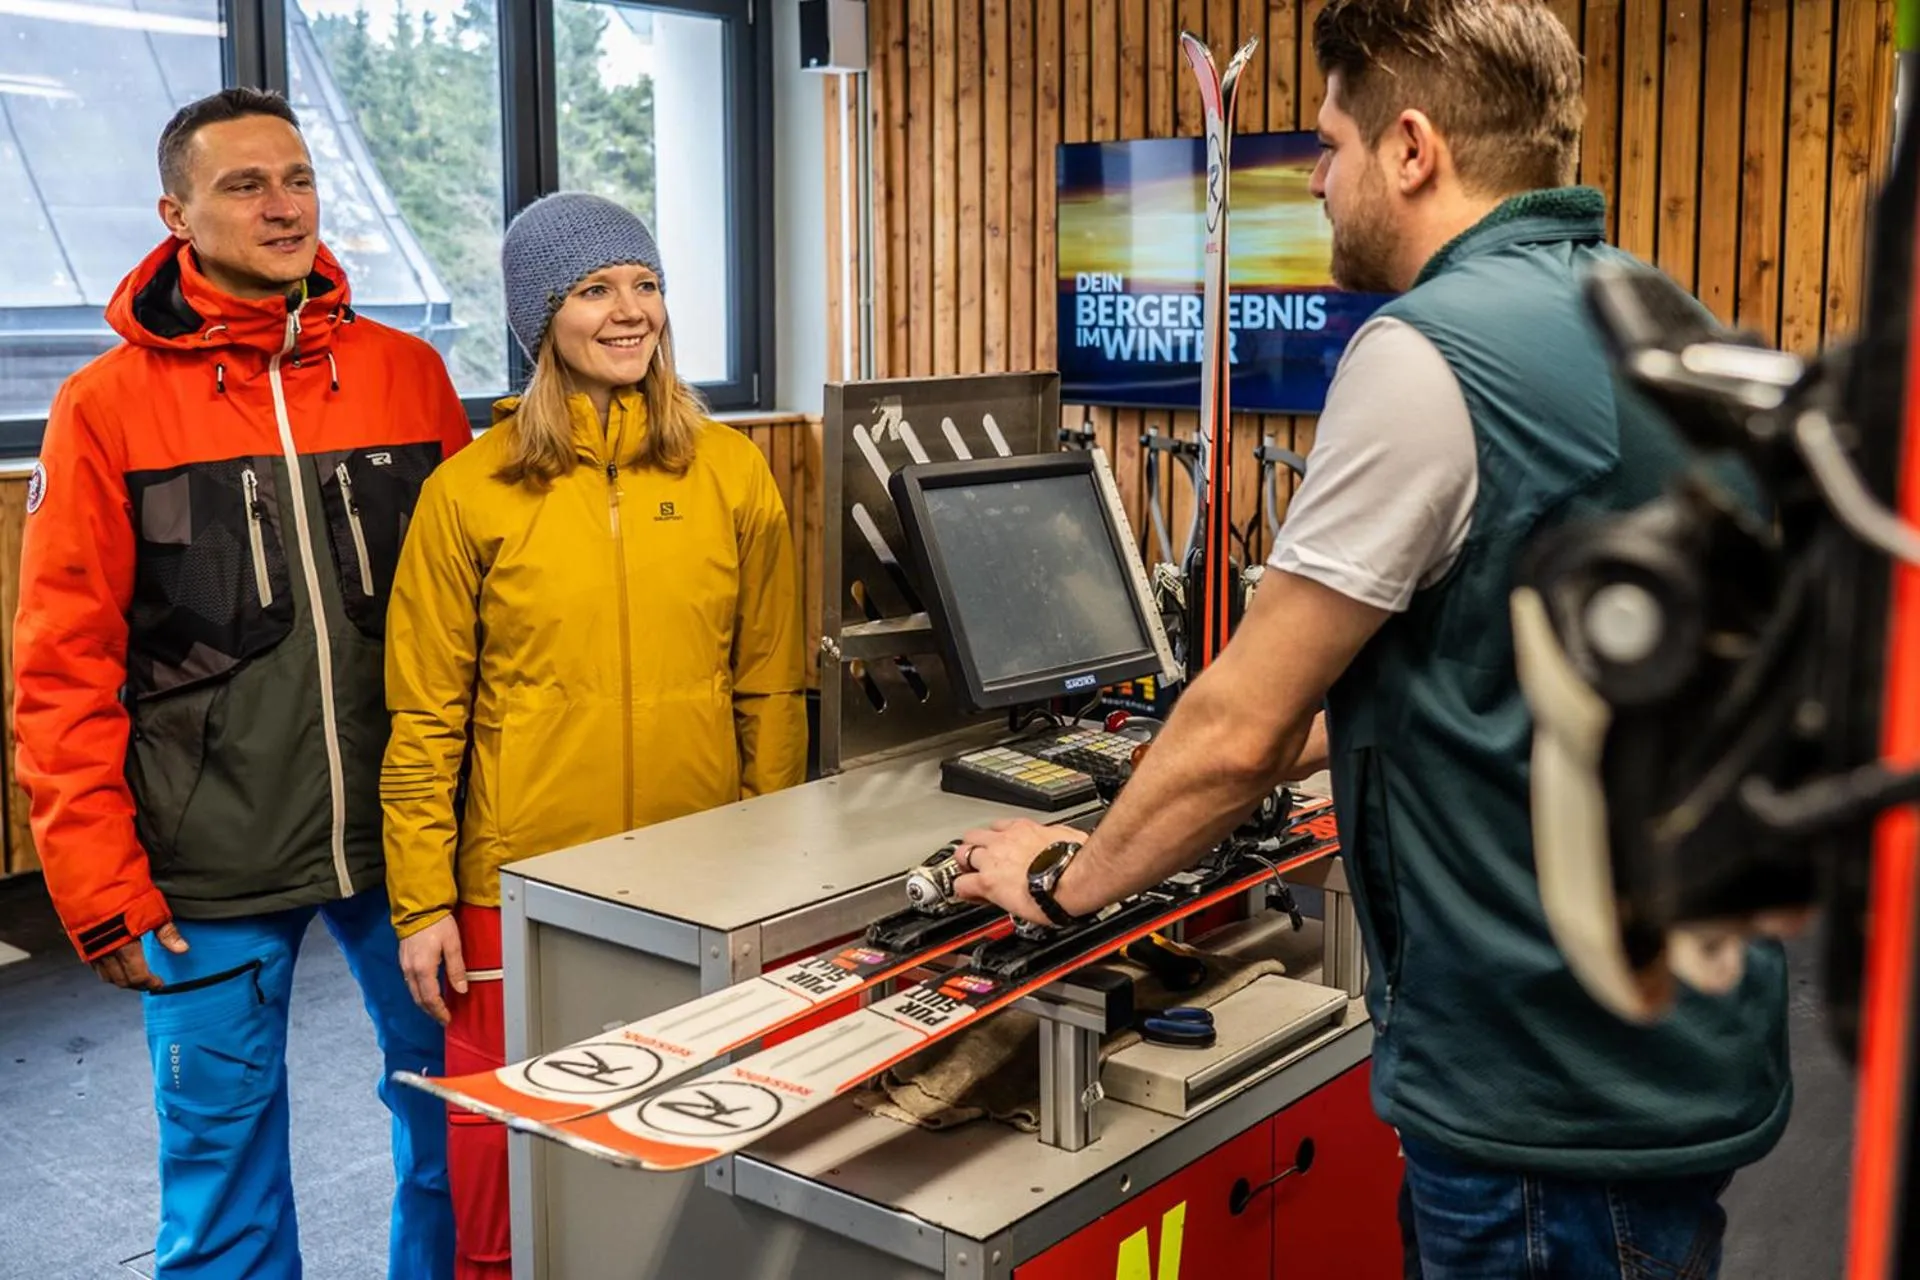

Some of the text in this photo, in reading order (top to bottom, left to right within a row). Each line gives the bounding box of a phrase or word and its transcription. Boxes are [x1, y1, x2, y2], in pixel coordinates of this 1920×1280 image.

[1076, 272, 1123, 293] DEIN
[1076, 294, 1327, 330] BERGEREBNIS
[1076, 327, 1100, 347] IM
[786, 970, 837, 995] PUR
[904, 986, 958, 1014] SUIT
[894, 1001, 950, 1027] PUR
